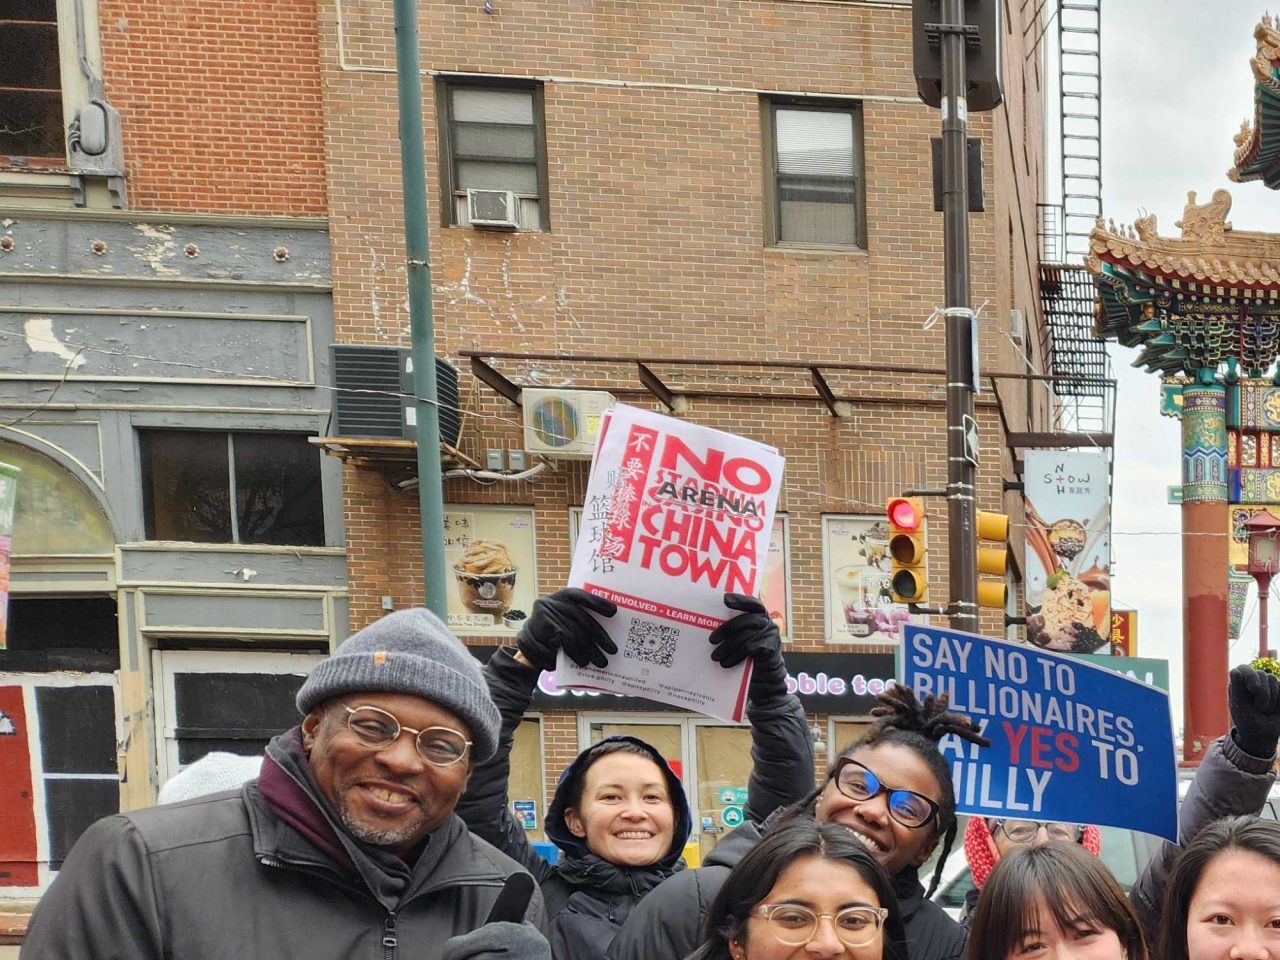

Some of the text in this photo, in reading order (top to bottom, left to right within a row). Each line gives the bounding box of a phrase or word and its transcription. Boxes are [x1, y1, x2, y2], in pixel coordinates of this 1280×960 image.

[659, 434, 772, 495] NO
[657, 481, 758, 517] ARENA
[641, 504, 757, 567] CHINA
[638, 537, 757, 597] TOWN
[591, 588, 610, 600] GET
[611, 594, 657, 612] INVOLVED
[666, 609, 697, 623] LEARN
[912, 633, 972, 674] SAY
[984, 645, 1027, 684] NO
[1037, 658, 1076, 696] TO
[938, 718, 1139, 786] AY YES TO
[954, 760, 1053, 813] ILLY
